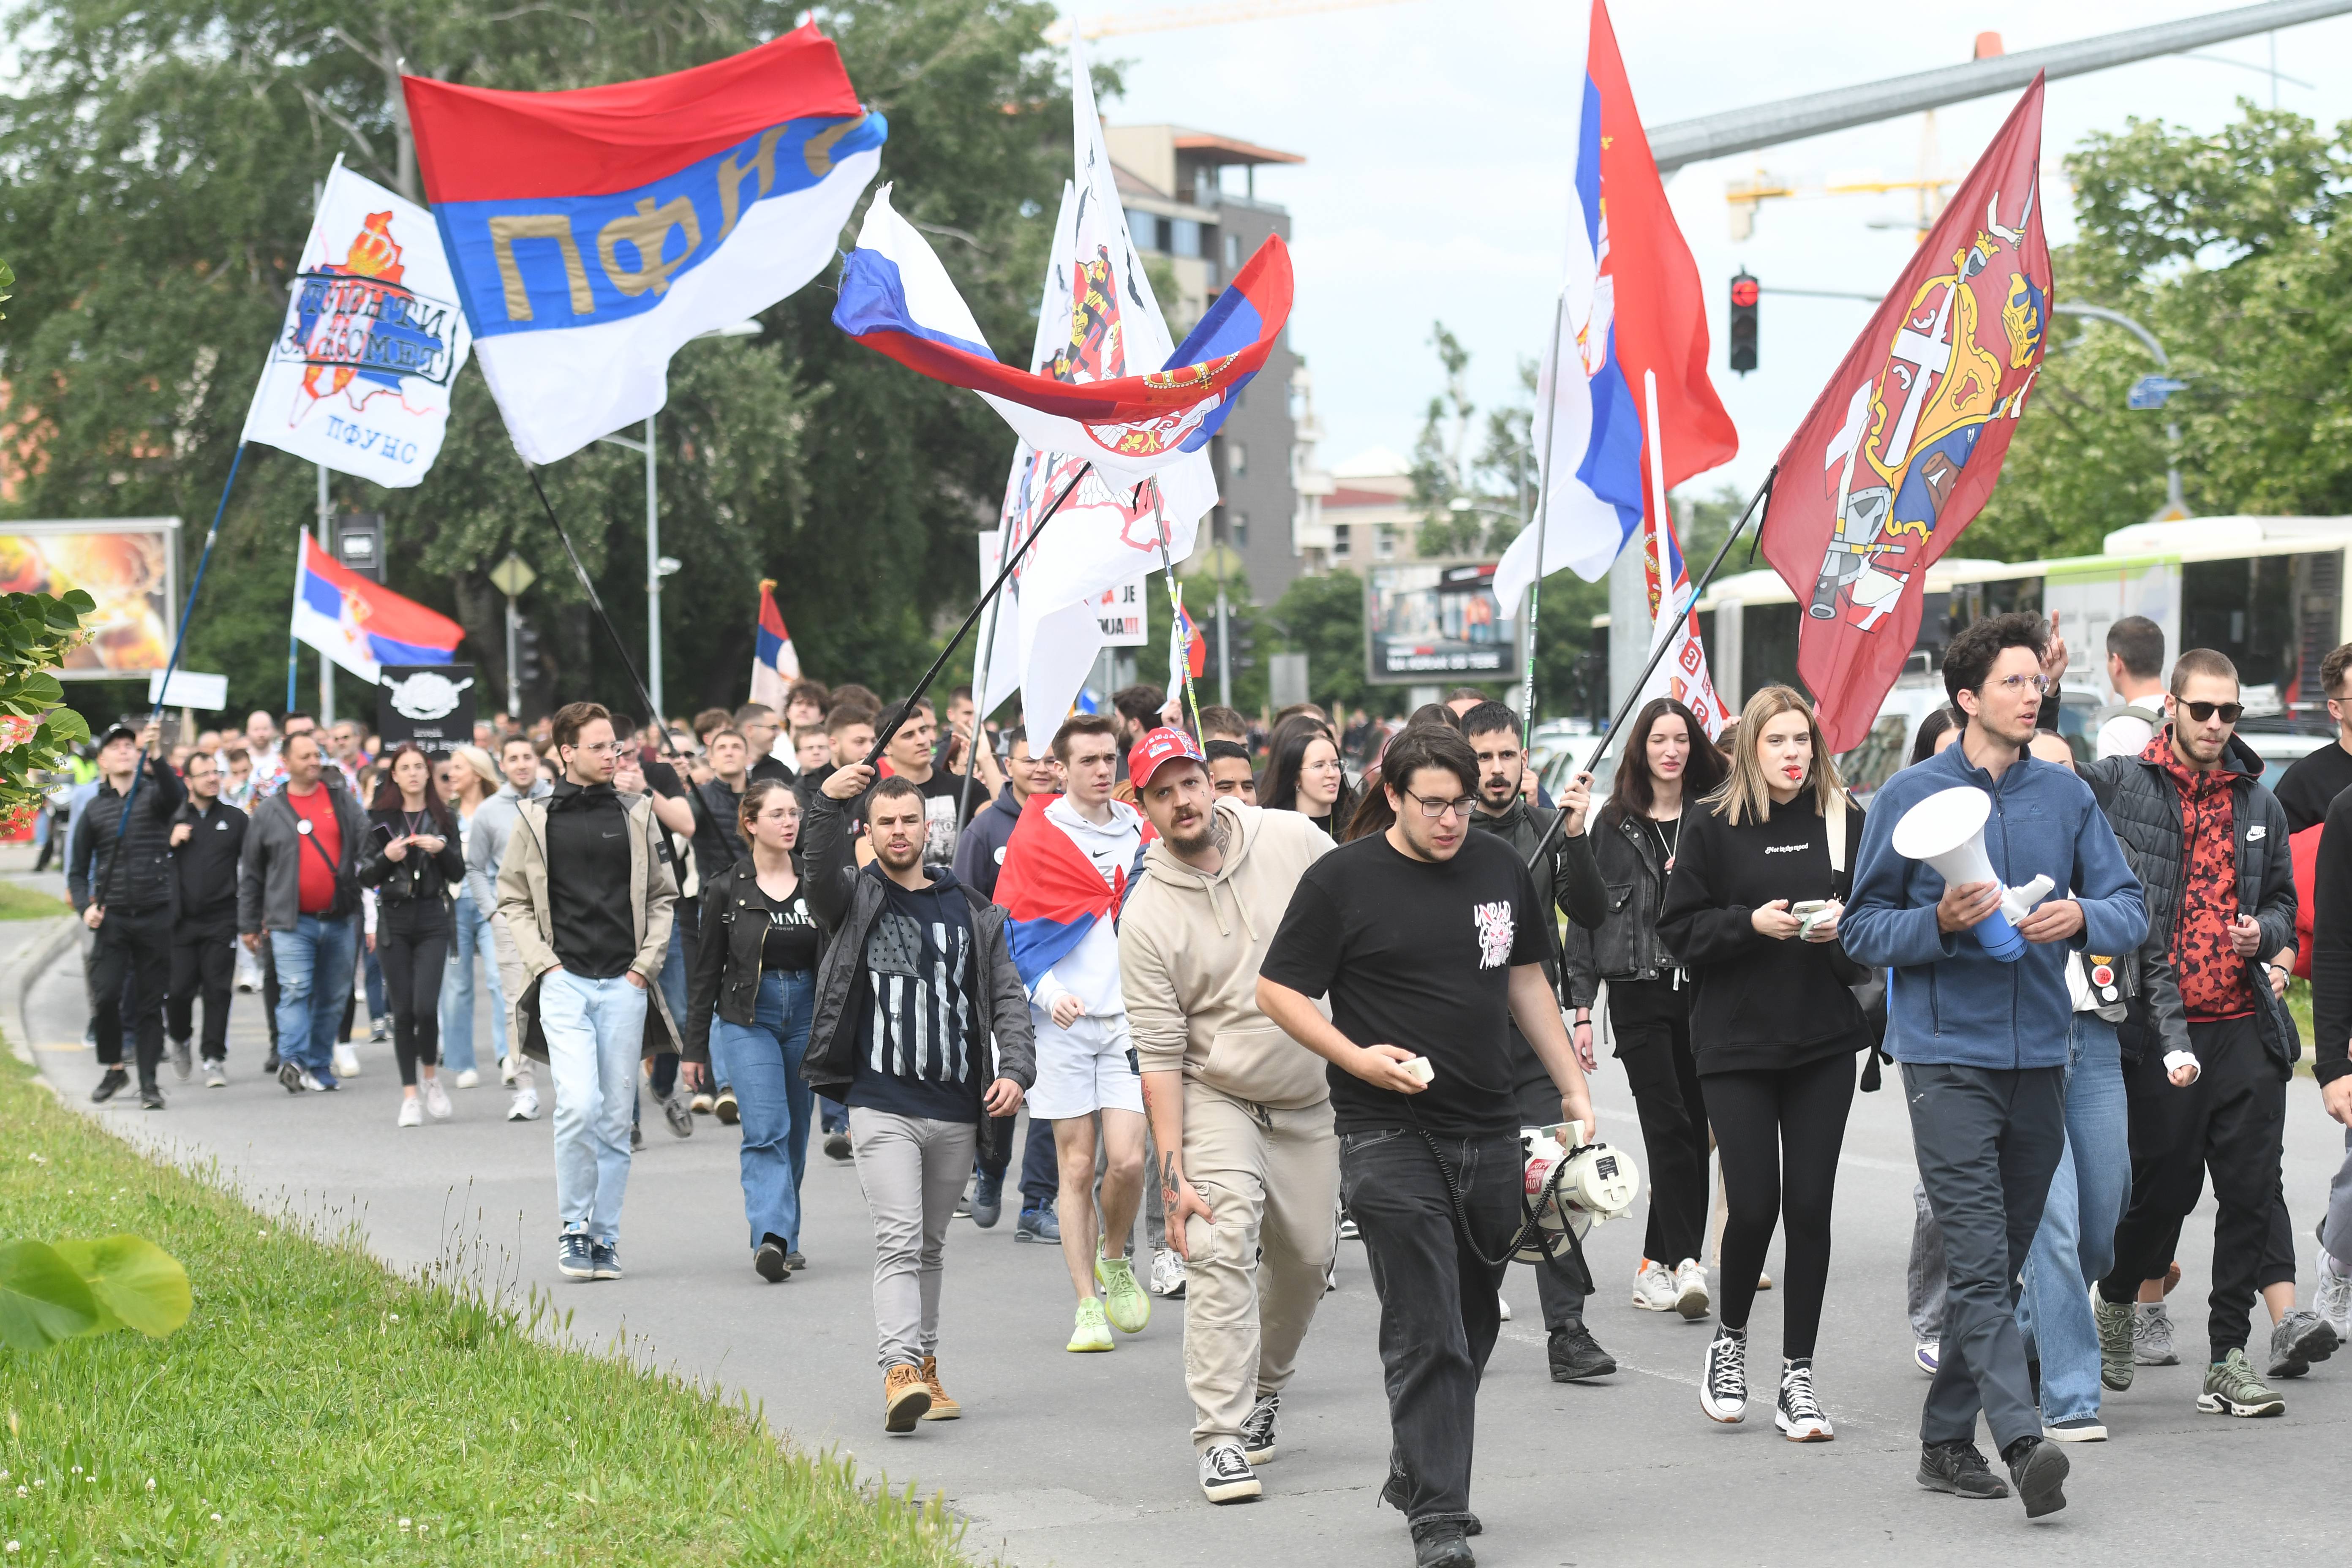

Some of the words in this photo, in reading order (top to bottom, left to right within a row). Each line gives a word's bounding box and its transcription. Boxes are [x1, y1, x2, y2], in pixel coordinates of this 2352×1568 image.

[296, 283, 446, 339] ТУДЕНТИ
[327, 415, 417, 464] ПФУНС
[1124, 586, 1135, 602] JE
[2250, 825, 2266, 835] NIKE
[1794, 843, 1808, 851] mood
[1525, 1177, 1540, 1190] NOVI
